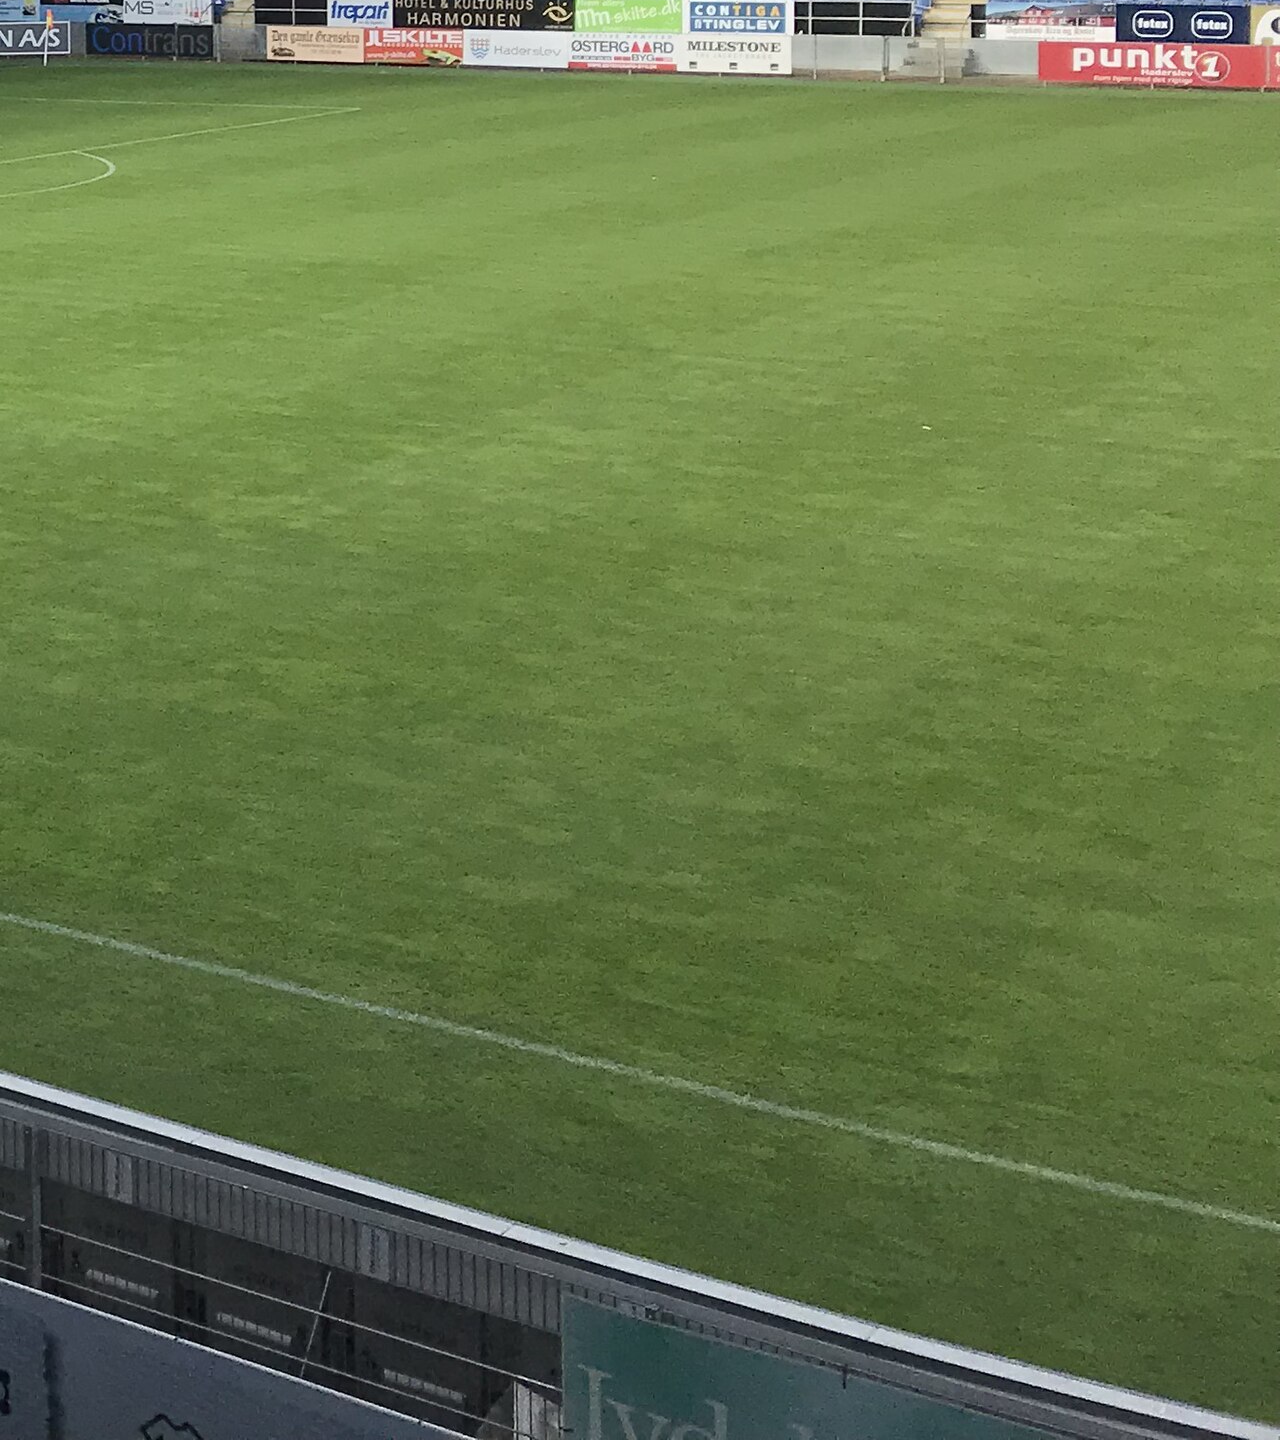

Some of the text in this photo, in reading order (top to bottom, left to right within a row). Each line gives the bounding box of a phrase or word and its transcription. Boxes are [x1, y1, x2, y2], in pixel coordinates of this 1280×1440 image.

[694, 4, 780, 17] CONTIGA
[406, 12, 521, 27] HARMONIEN
[17, 28, 61, 48] A/S
[92, 26, 209, 56] Contrans
[493, 45, 562, 57] Haderslev
[687, 40, 782, 53] MILESTONE
[1072, 44, 1198, 72] punkt
[1140, 68, 1194, 78] Haderslev
